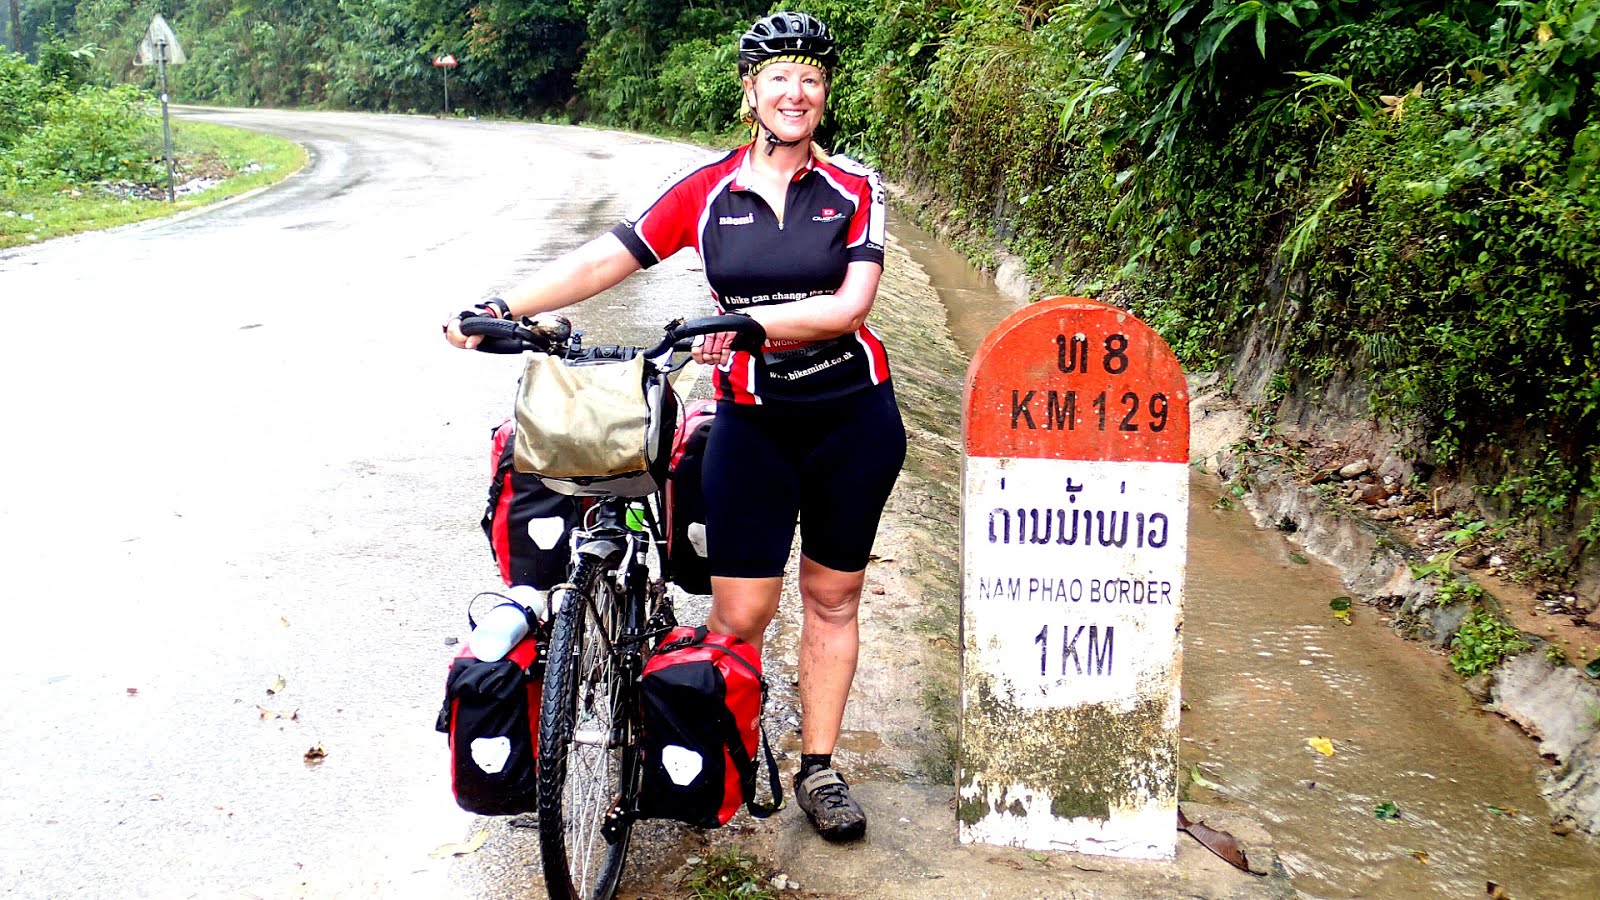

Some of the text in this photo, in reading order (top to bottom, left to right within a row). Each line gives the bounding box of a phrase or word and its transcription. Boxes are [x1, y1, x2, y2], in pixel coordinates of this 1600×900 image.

[719, 213, 754, 225] naomi
[730, 296, 750, 304] bike
[752, 294, 770, 303] can
[772, 292, 807, 301] change
[1102, 334, 1129, 374] 8
[1010, 389, 1169, 433] KM 129
[979, 577, 1172, 605] NAM PHAO BORDER
[1035, 624, 1114, 676] 1 KM
